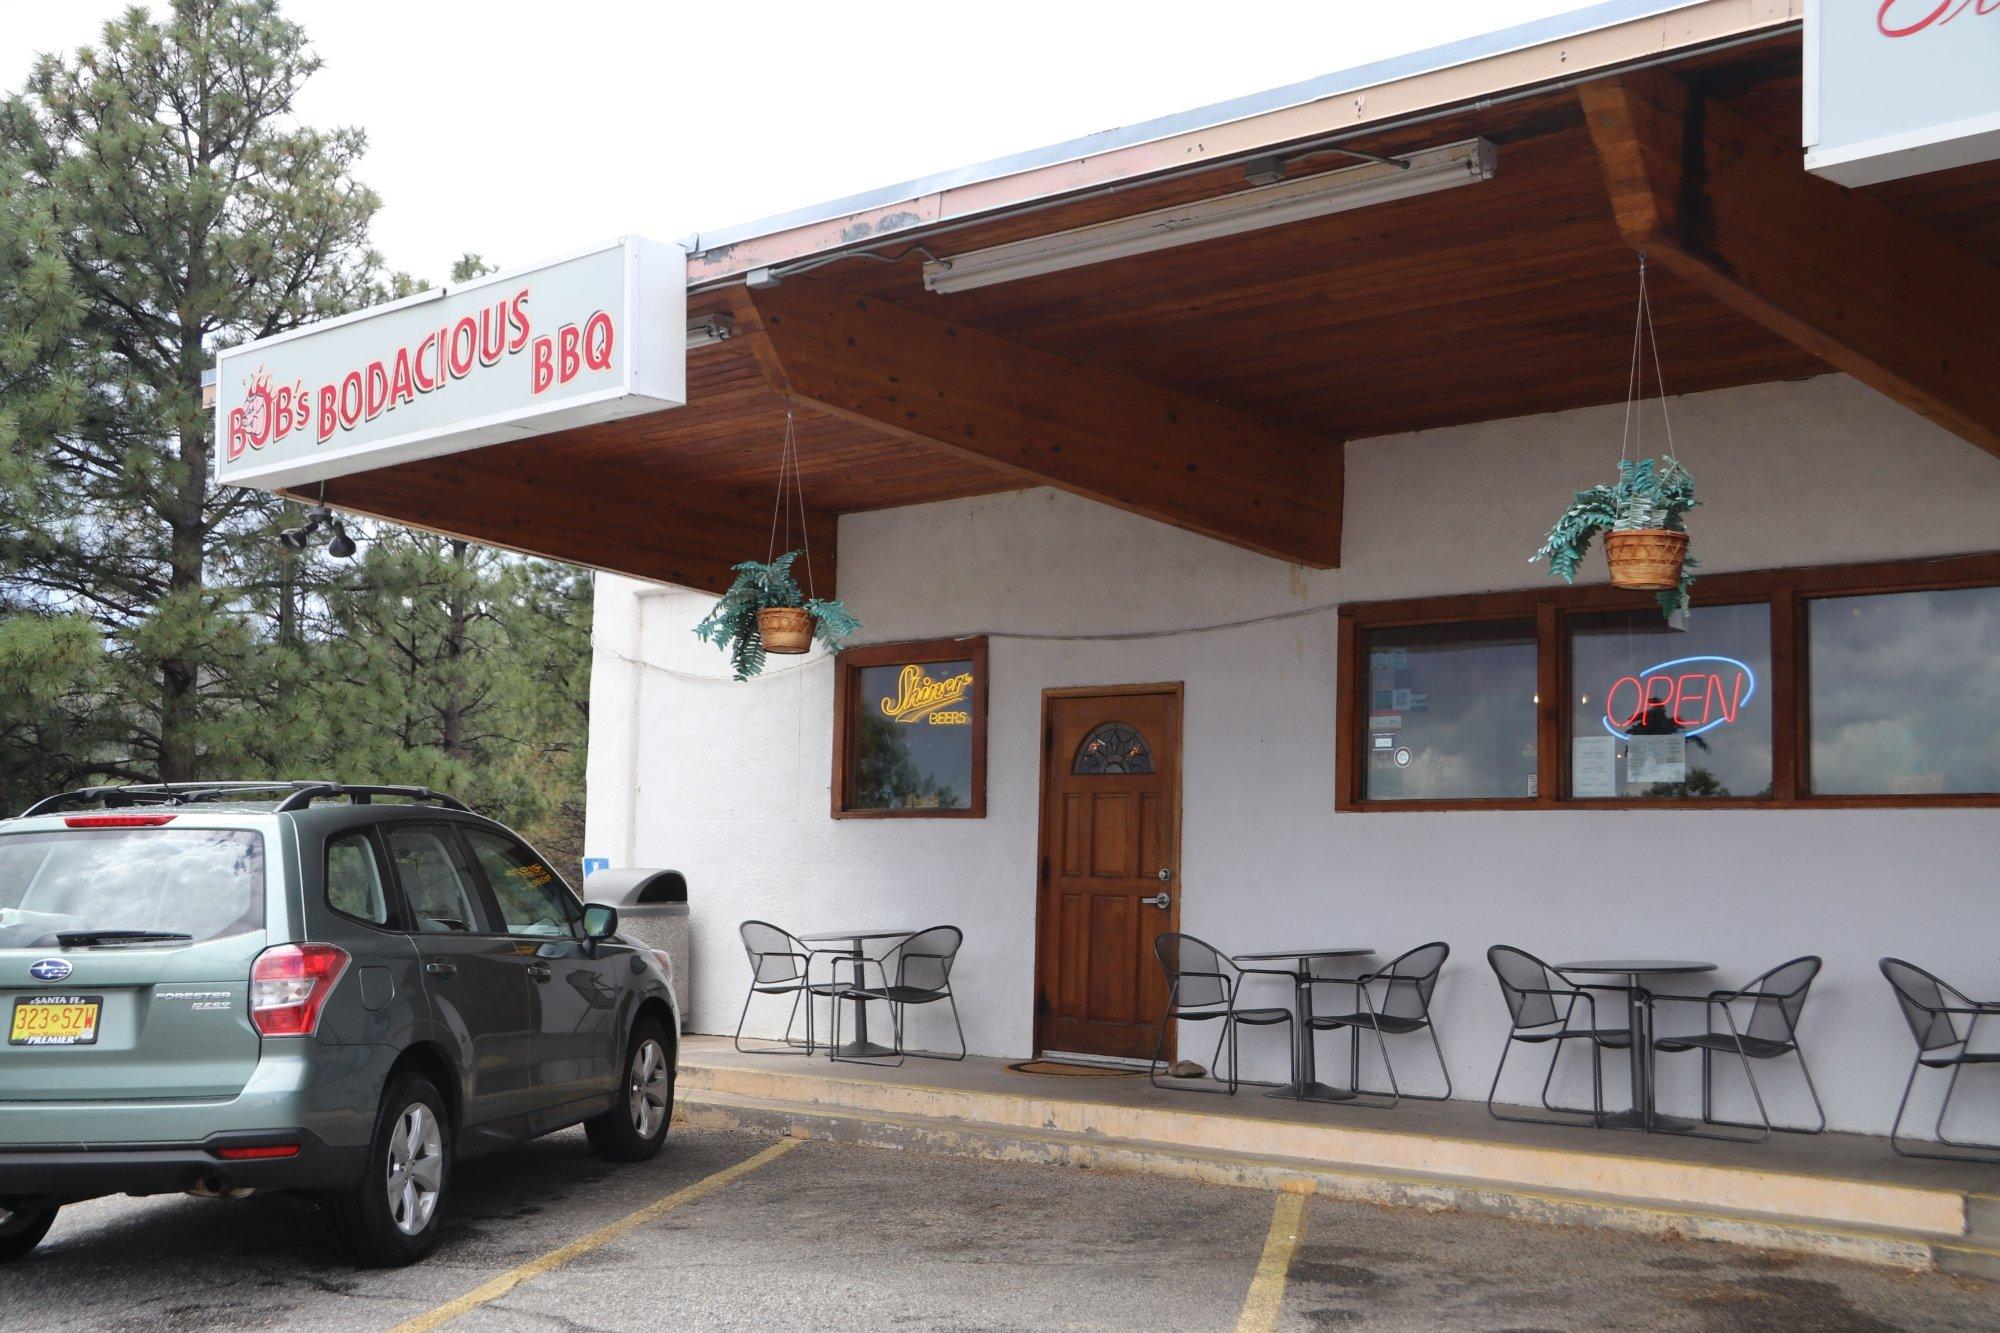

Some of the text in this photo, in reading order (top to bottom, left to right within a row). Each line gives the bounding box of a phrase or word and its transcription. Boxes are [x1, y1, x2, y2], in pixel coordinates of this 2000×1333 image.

[317, 287, 531, 444] BODACIOUS
[532, 309, 614, 396] BBQ
[881, 664, 974, 716] Shiner
[1606, 672, 1742, 728] OPEN
[34, 996, 81, 1005] SANTA FE
[155, 991, 231, 1001] FORESTER
[17, 1007, 50, 1029] 323
[29, 1035, 76, 1044] PREMIER
